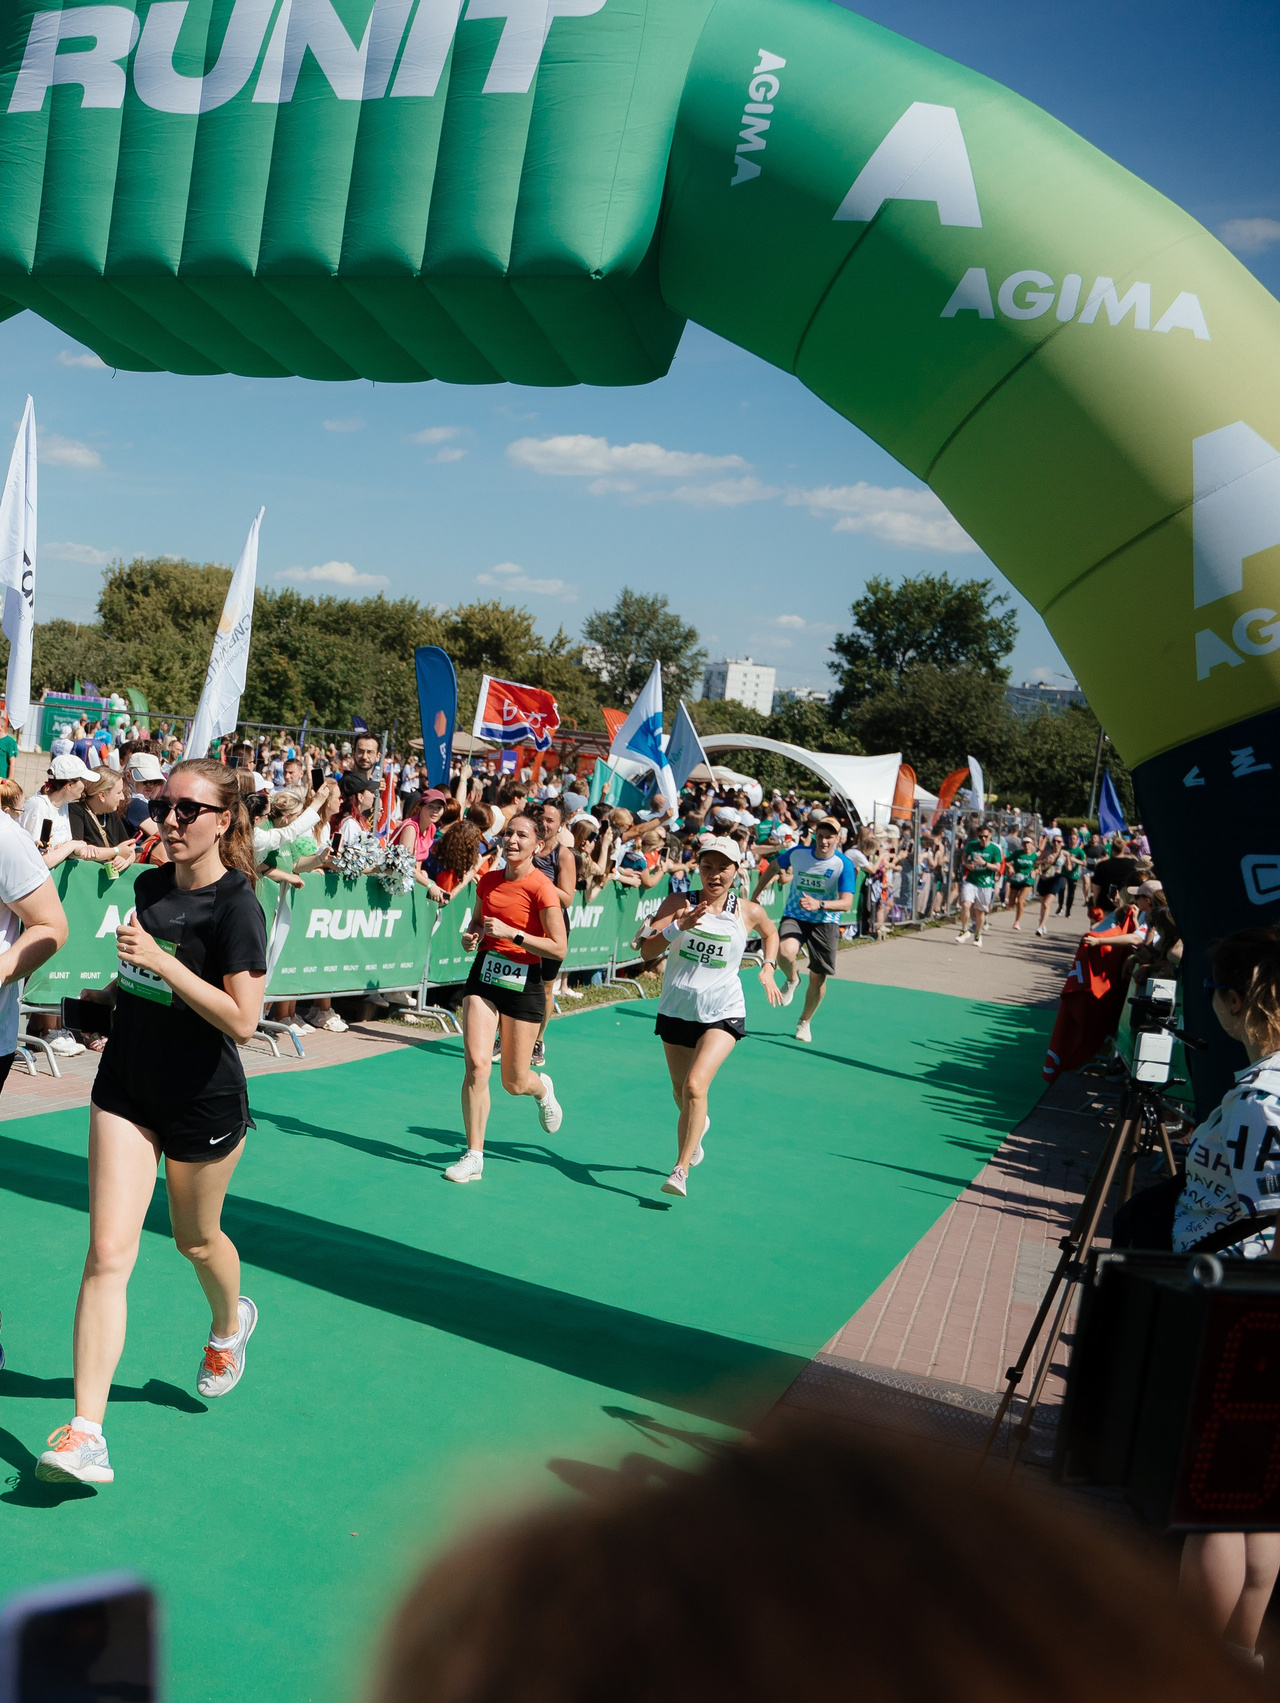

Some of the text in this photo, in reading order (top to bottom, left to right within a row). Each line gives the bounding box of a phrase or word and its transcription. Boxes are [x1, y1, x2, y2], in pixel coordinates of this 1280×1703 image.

[6, 0, 608, 115] RUNIT
[731, 48, 786, 186] AGIMA
[939, 267, 1212, 342] AGIMA
[801, 878, 821, 887] 2145
[725, 891, 737, 913] PRO
[306, 909, 403, 940] RUNIT
[567, 905, 604, 930] UNIT
[687, 939, 724, 957] 1081
[700, 953, 711, 964] B
[483, 972, 492, 982] B
[486, 960, 522, 979] 1804
